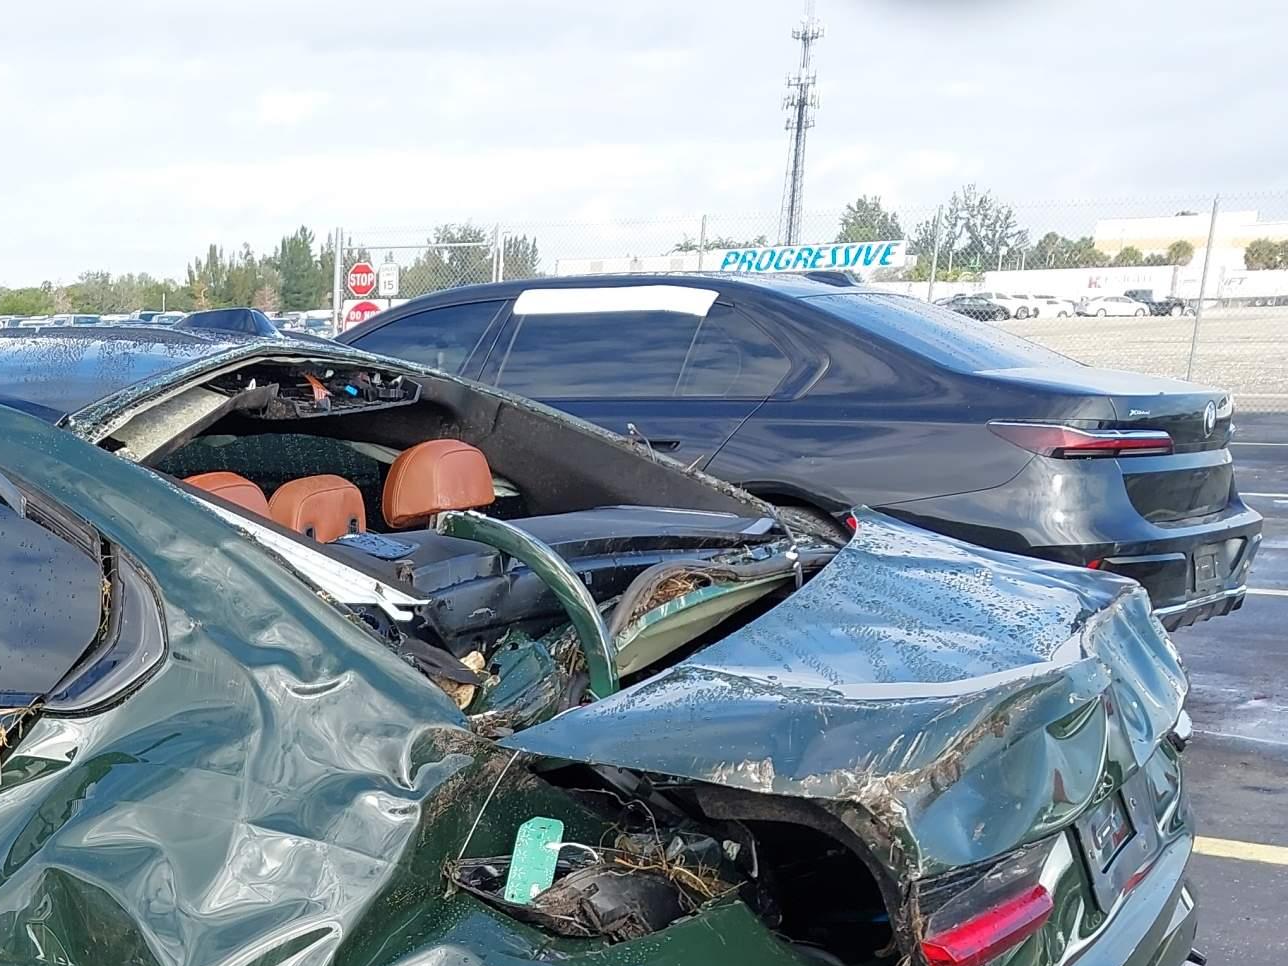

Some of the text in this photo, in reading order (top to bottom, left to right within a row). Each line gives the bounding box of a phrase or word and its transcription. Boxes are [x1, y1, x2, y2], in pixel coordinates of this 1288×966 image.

[719, 243, 900, 272] PROGRESSIVE
[350, 273, 374, 286] STOP
[383, 280, 394, 290] 15
[350, 311, 361, 320] DO
